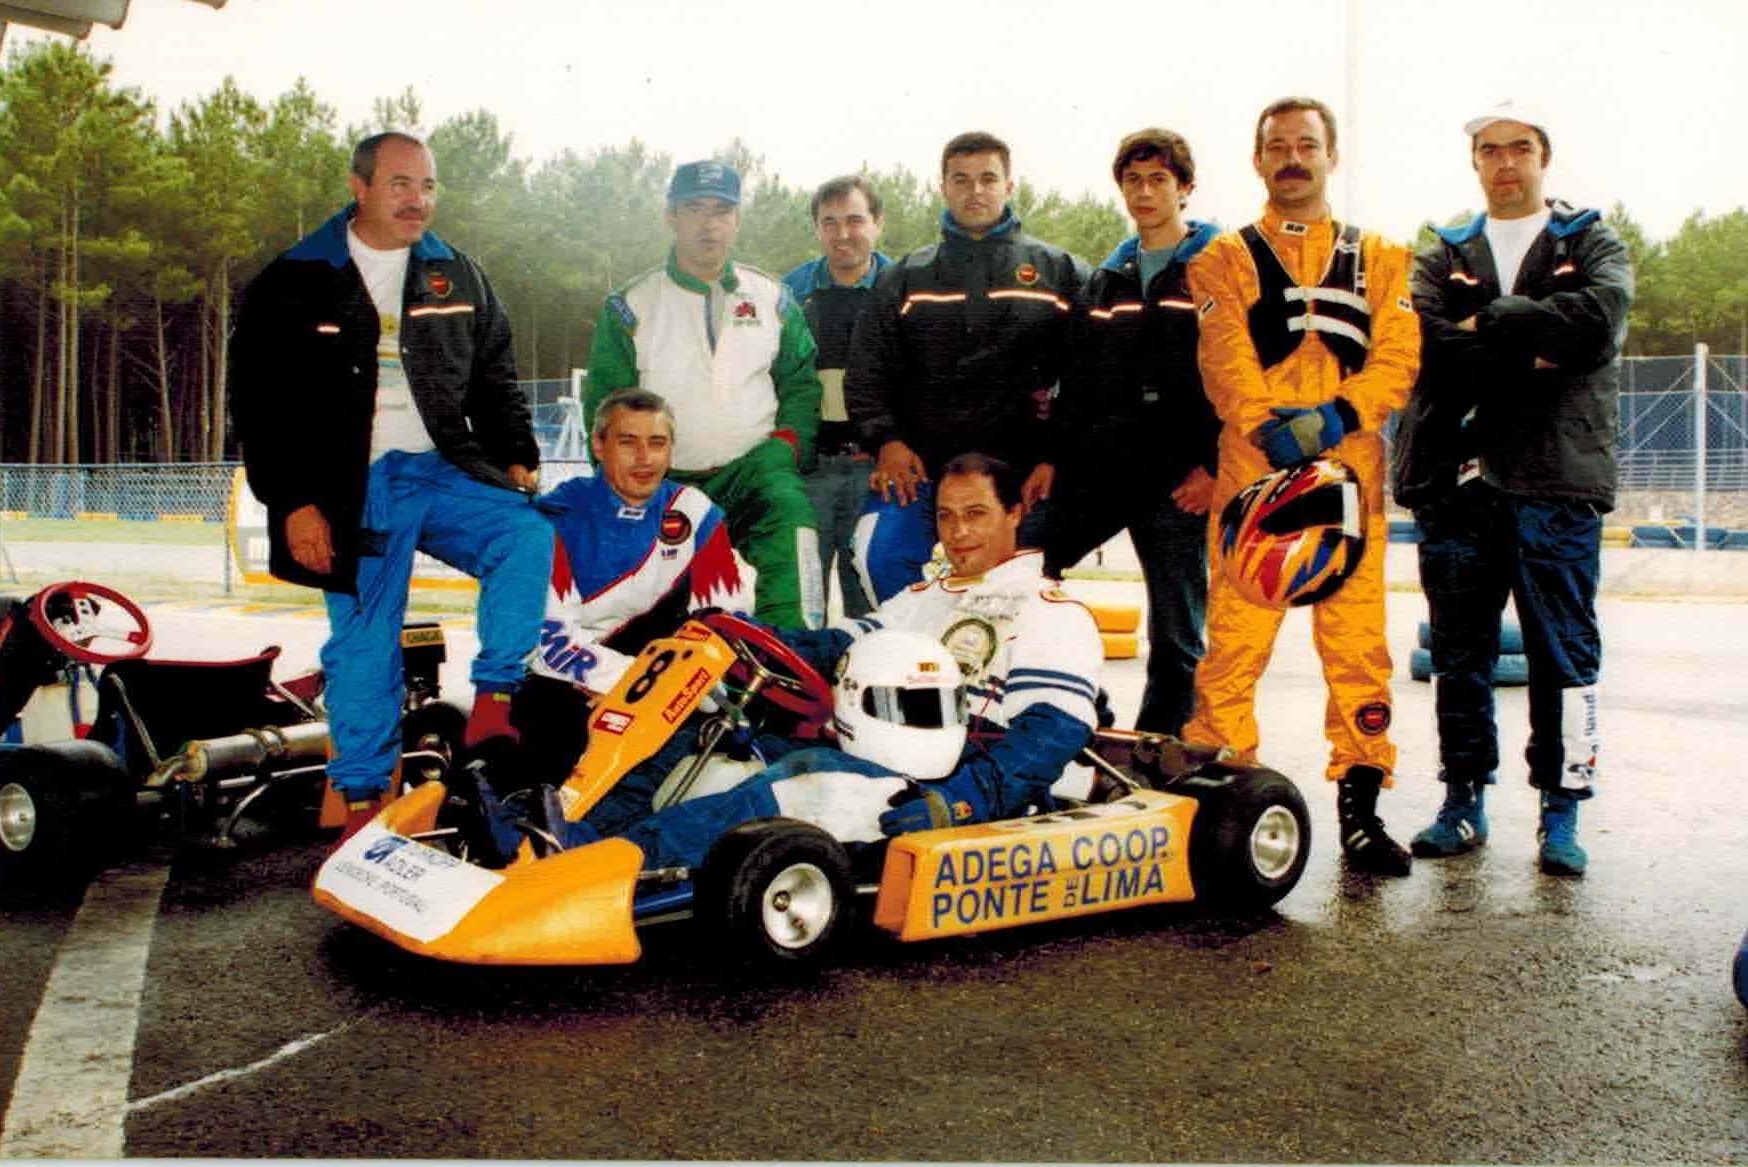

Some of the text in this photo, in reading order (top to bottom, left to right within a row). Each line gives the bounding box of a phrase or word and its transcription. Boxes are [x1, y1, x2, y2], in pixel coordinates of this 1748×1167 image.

[625, 649, 676, 704] 8
[935, 841, 1056, 888] ADEGA
[933, 864, 1163, 928] PONTE DE LIMA
